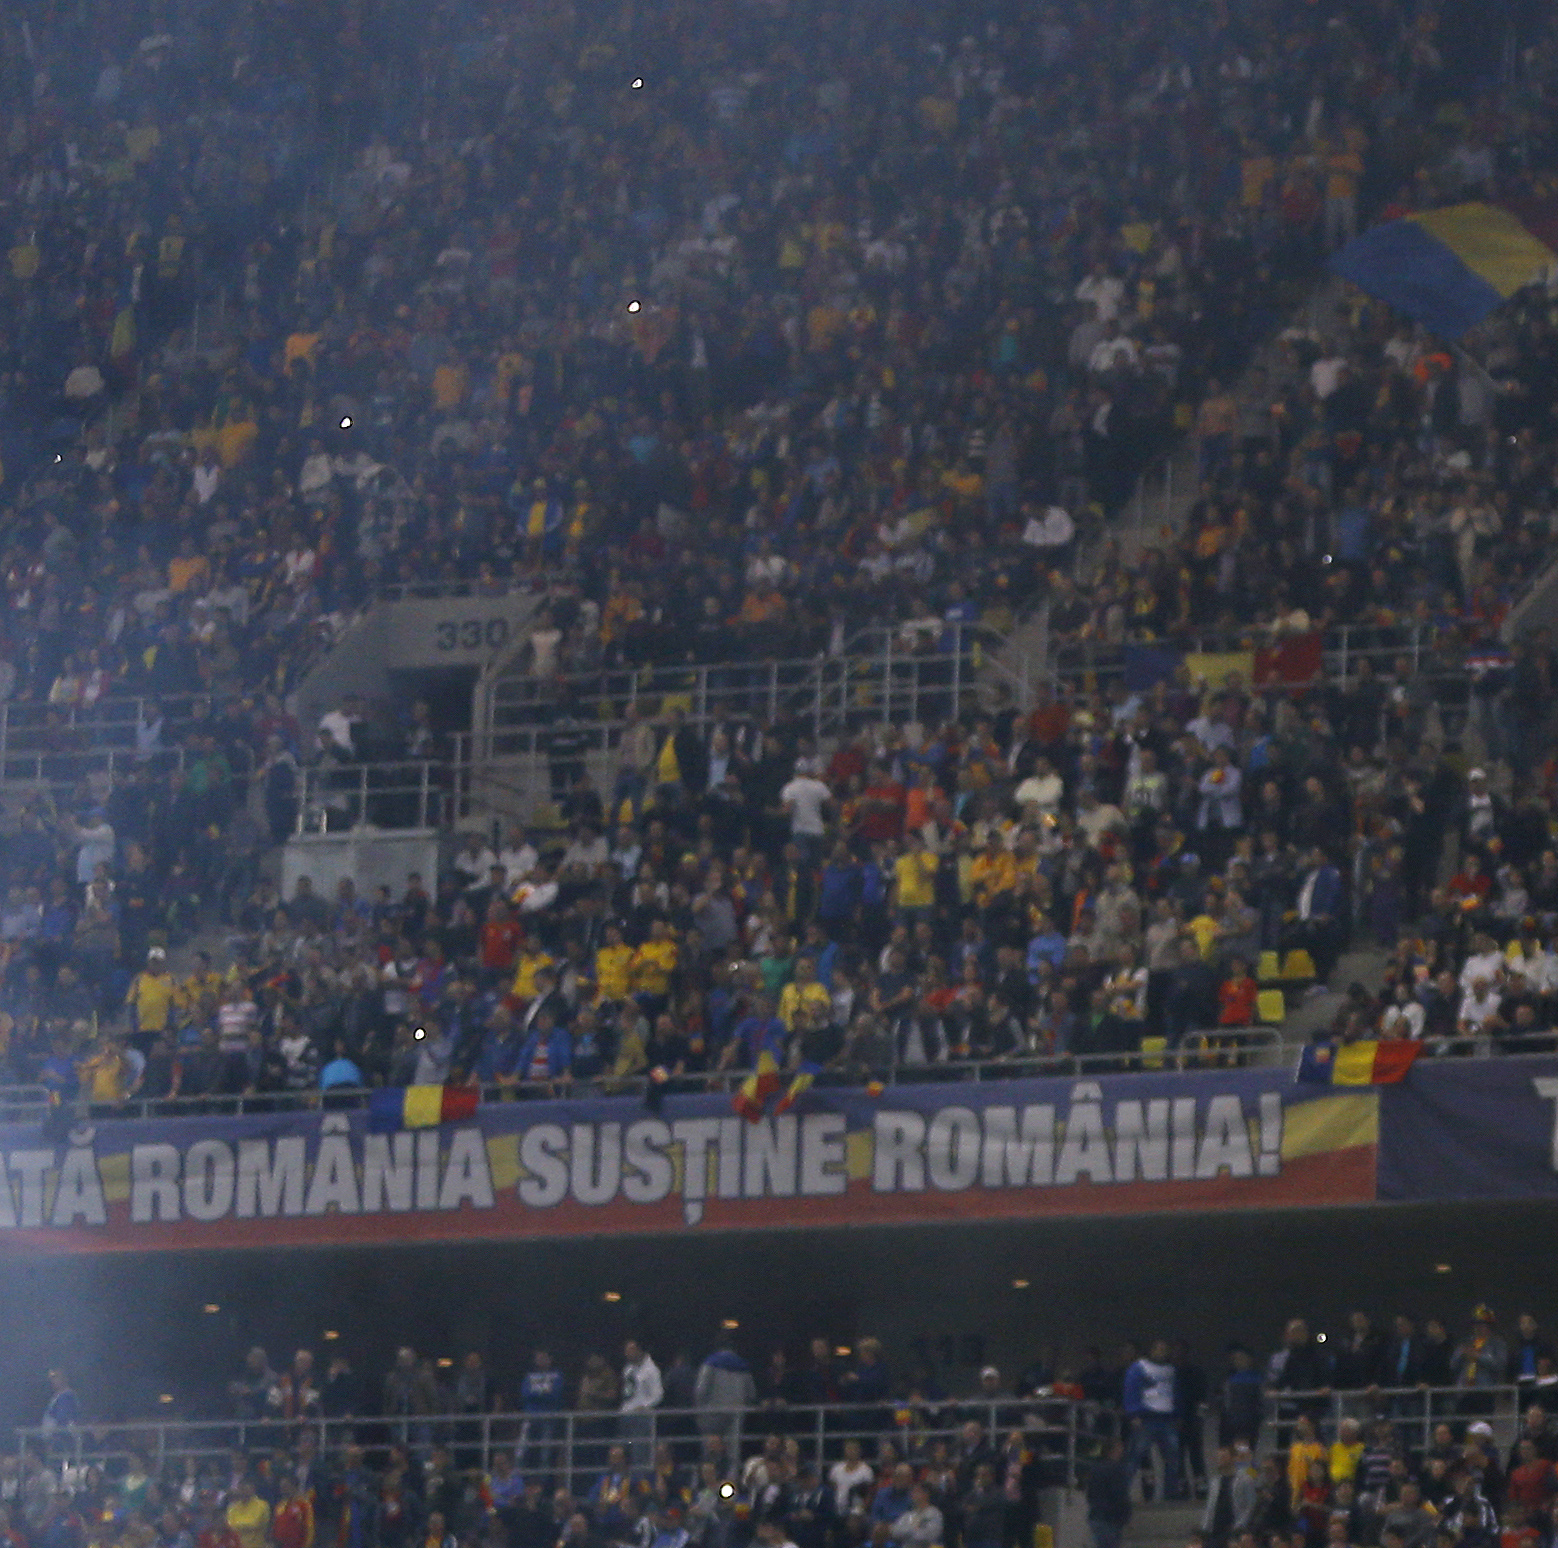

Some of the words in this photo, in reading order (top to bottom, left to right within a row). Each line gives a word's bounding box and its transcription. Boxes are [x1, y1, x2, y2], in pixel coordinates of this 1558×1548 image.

[437, 617, 508, 650] 330
[0, 1127, 106, 1227] TĂ
[131, 1112, 496, 1222] ROMÂNIA
[873, 1082, 1282, 1192] ROMÂNIA!
